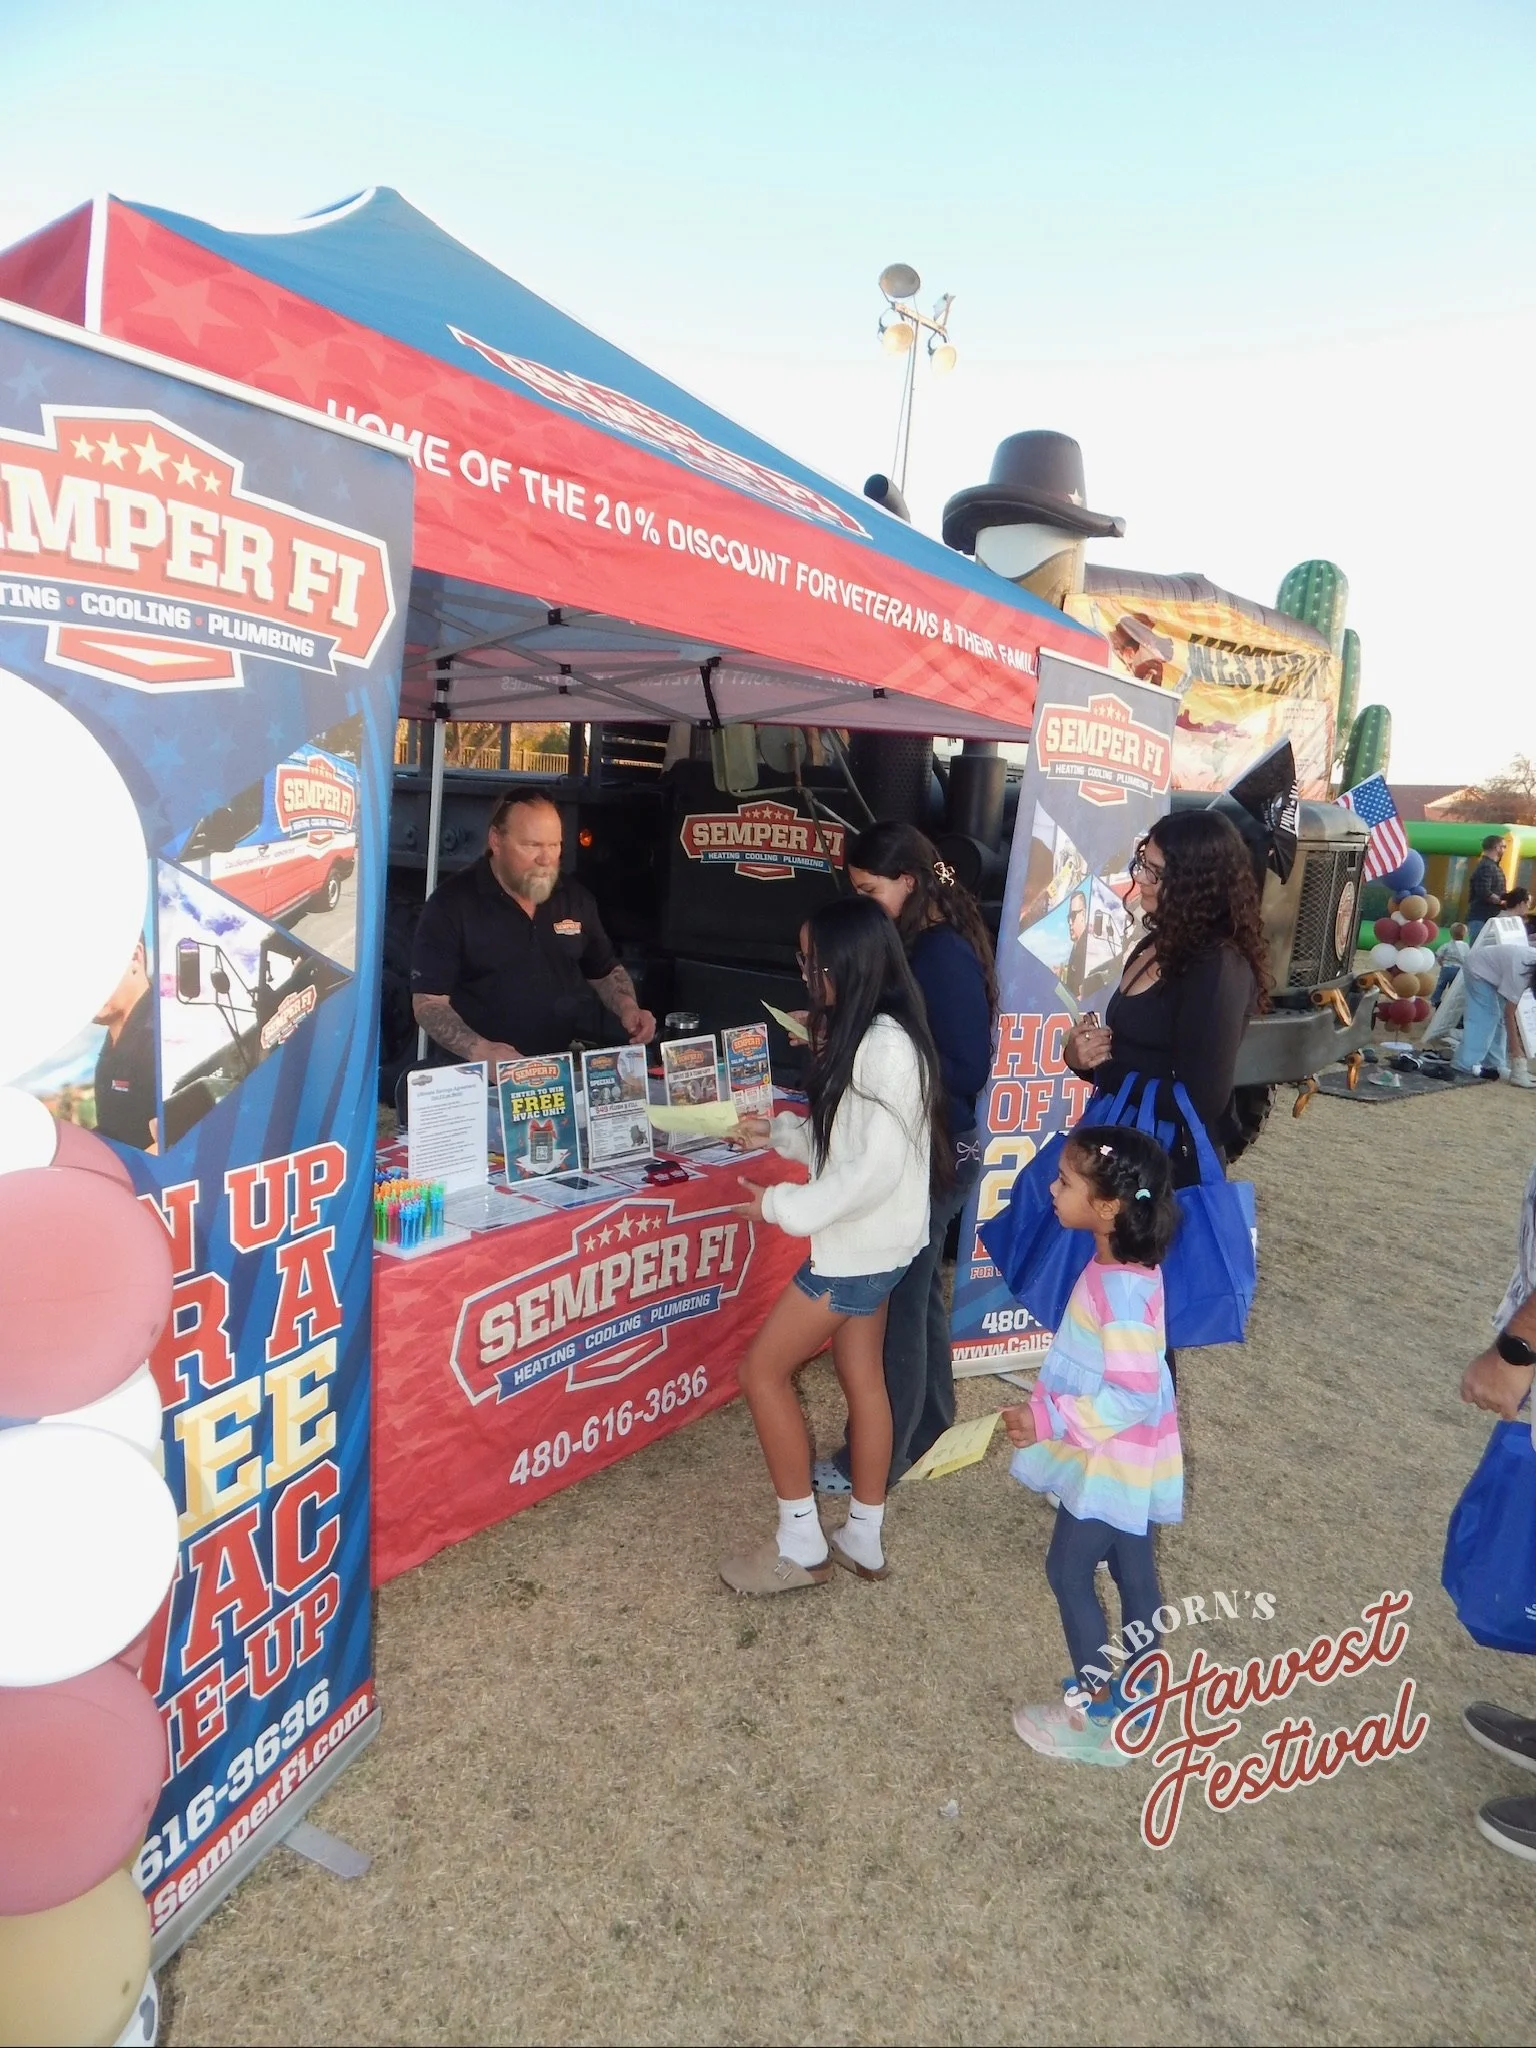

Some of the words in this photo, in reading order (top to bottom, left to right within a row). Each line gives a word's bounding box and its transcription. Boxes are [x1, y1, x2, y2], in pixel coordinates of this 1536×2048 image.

[0, 463, 274, 601] MPER
[288, 537, 366, 628] FI
[459, 449, 512, 493] OF
[518, 466, 587, 521] THE
[594, 493, 661, 545] 20%
[667, 518, 791, 586] DISCOUNT
[796, 562, 838, 604] FOR
[838, 579, 939, 639] VETERANS
[942, 618, 954, 645] &
[954, 623, 997, 660] THEIR
[81, 592, 191, 630] COOLING
[208, 613, 315, 658] PLUMBING
[1046, 717, 1140, 767] SEMPER
[1142, 739, 1164, 776] FI
[1055, 764, 1084, 776] HEATING
[1088, 767, 1112, 781] COOLING
[283, 778, 341, 813] SEMPER
[341, 790, 352, 817] FI
[692, 822, 808, 850] SEMPER
[812, 829, 844, 857] FI
[708, 852, 740, 860] HEATING
[745, 852, 778, 862] COOLING
[783, 855, 823, 868] PLUMBING
[511, 1089, 536, 1099] ENTER
[538, 1088, 547, 1096] TO
[548, 1086, 564, 1094] WIN
[514, 1067, 548, 1081] SEMPER
[549, 1066, 557, 1075] FI
[511, 1092, 566, 1114] FREE
[512, 1110, 541, 1122] HVAC
[542, 1107, 566, 1117] UNIT
[987, 1079, 1054, 1133] OF
[225, 1141, 347, 1254] UP
[265, 1225, 342, 1363] A
[479, 1233, 689, 1365] SEMPER
[695, 1223, 739, 1279] FI
[970, 1265, 994, 1280] FOR
[514, 1343, 575, 1386] HEATING
[585, 1314, 641, 1351] COOLING
[650, 1292, 711, 1323] PLUMBING
[952, 1331, 1054, 1361] www.CallS
[508, 1365, 708, 1486] 480-616-3636
[150, 1693, 368, 1931] SemperFi.com
